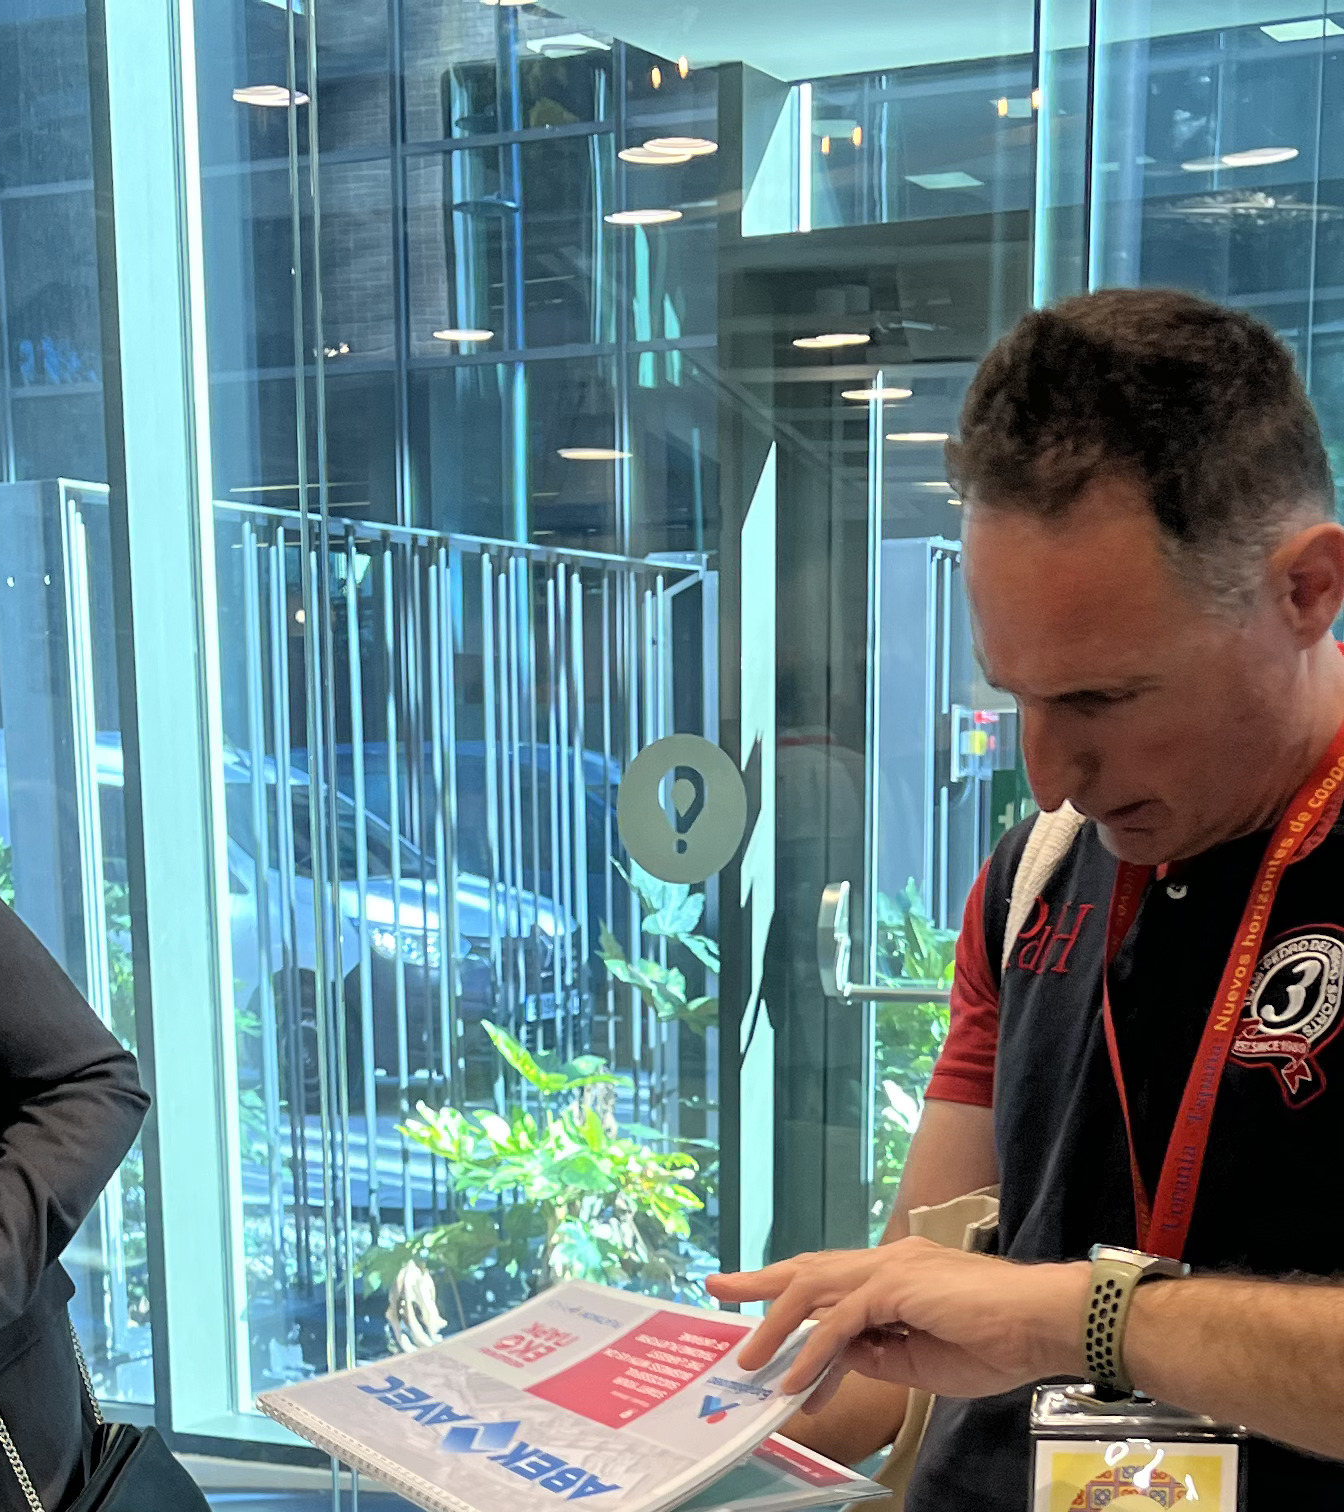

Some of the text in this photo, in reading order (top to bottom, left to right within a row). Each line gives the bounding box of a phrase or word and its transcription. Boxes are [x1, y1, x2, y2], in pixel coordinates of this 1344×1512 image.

[1214, 953, 1251, 1032] Nuevos
[1241, 837, 1294, 948] horizontes
[1289, 812, 1312, 832] de
[1260, 960, 1322, 1022] 3
[1302, 983, 1338, 1037] SPORTS
[357, 1375, 472, 1427] AVEC
